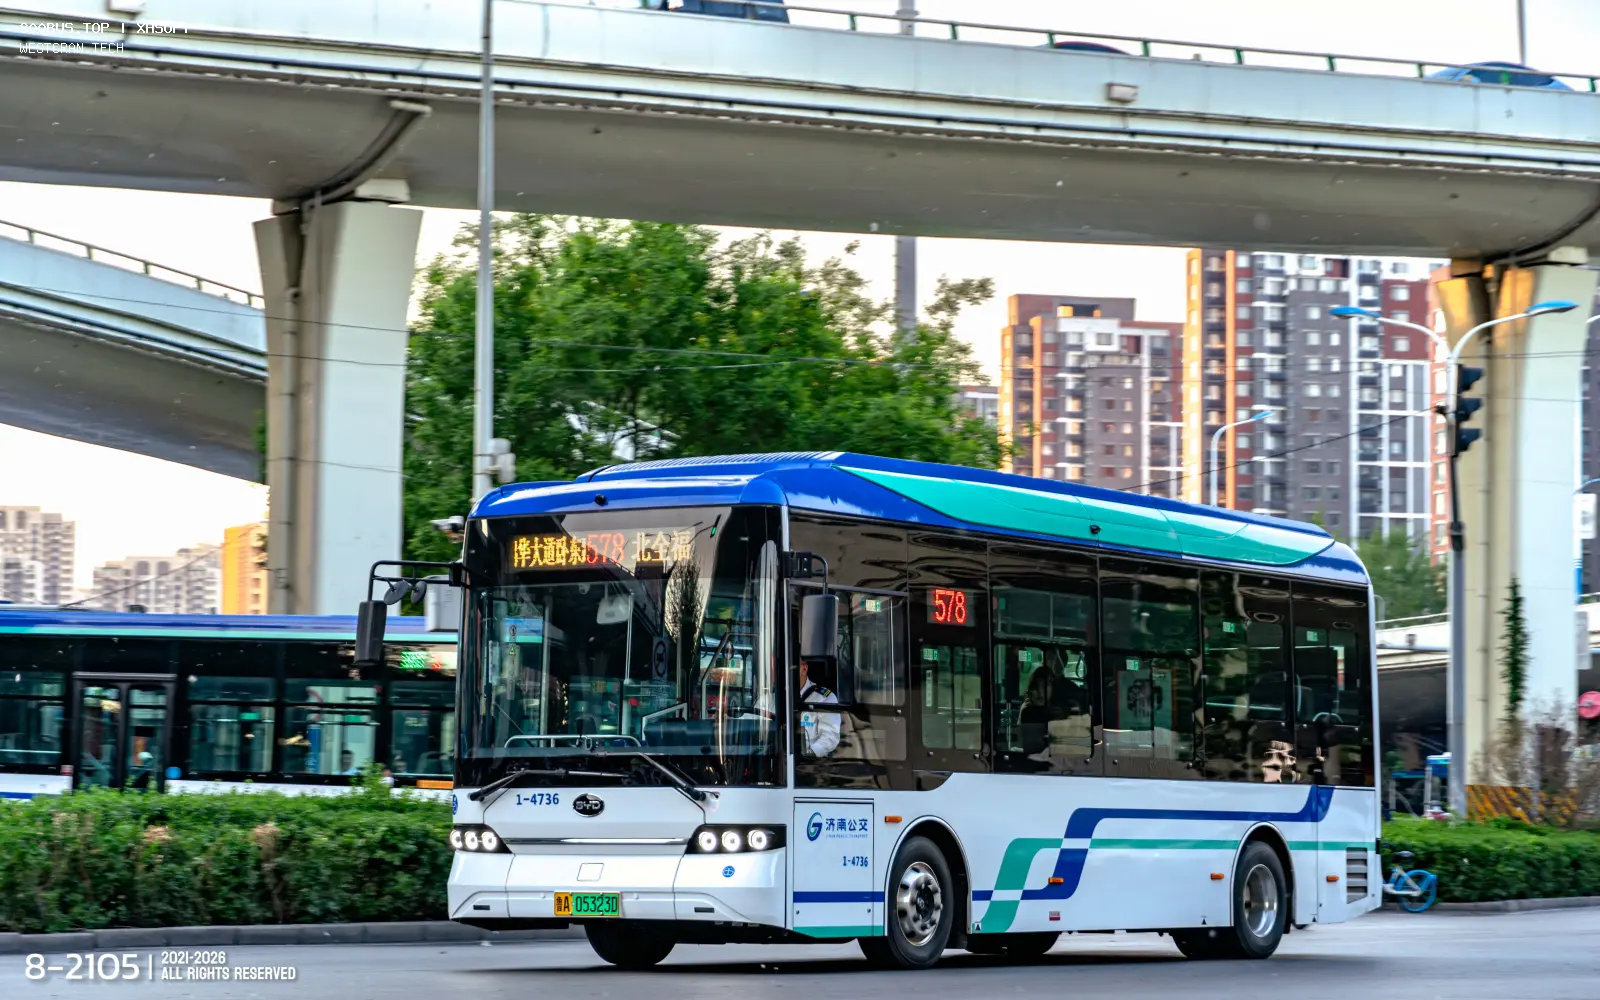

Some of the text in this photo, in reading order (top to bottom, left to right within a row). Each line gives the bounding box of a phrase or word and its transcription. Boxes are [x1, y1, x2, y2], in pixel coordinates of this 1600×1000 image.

[586, 533, 624, 564] 578
[934, 588, 967, 624] 578
[516, 793, 560, 806] 1-4736
[575, 800, 601, 810] BYD
[825, 817, 868, 832] 济南公交
[843, 855, 869, 867] 1-4736
